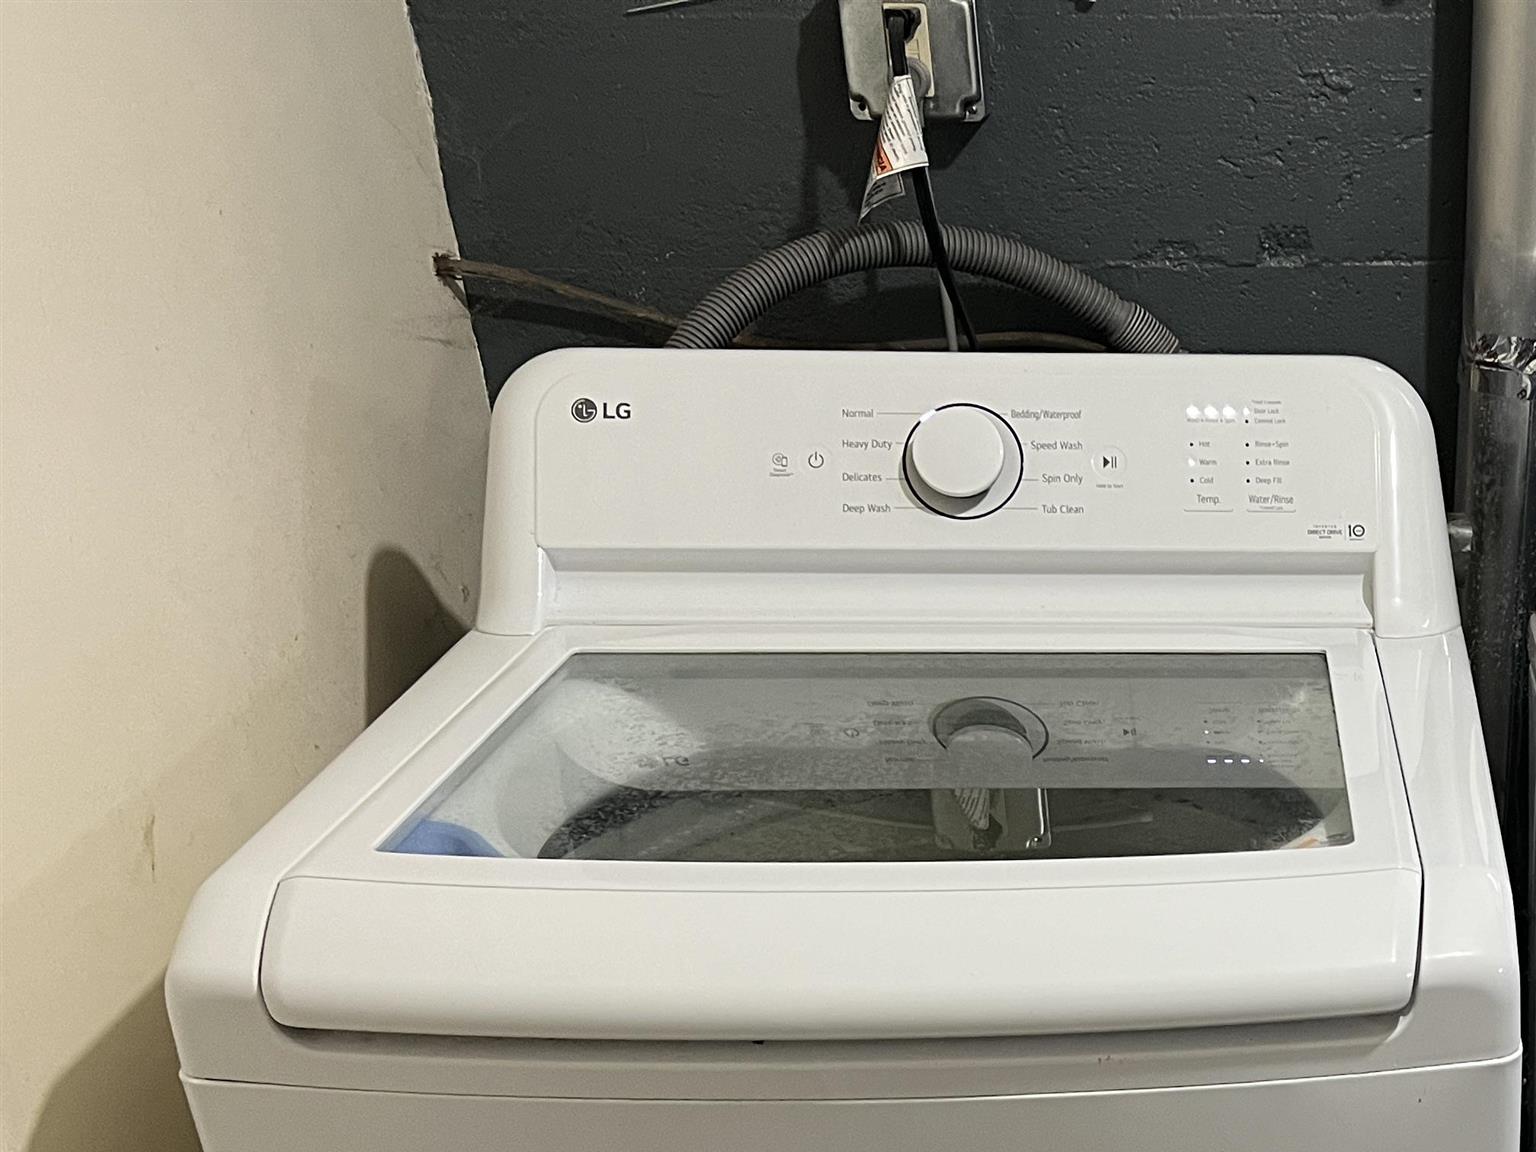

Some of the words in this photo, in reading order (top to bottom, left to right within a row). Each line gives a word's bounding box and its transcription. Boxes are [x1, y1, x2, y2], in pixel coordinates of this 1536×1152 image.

[602, 402, 632, 420] LG
[841, 408, 874, 419] Normal
[1010, 409, 1082, 421] Bedding/Waterproof
[841, 439, 869, 451] Heavy
[870, 439, 893, 451] Duty
[1030, 440, 1058, 452] Speed
[1059, 440, 1083, 450] Wash
[1199, 458, 1217, 466] Warm
[841, 472, 882, 482] Delicates
[1042, 473, 1062, 485] Spin
[1063, 473, 1084, 485] Only
[1199, 476, 1214, 485] Cold
[1255, 476, 1272, 486] Deep
[1248, 494, 1294, 506] Water/Rinse
[841, 503, 866, 515] Deep
[867, 503, 892, 513] Wash
[1041, 504, 1059, 514] Tub
[1061, 504, 1085, 514] Clean
